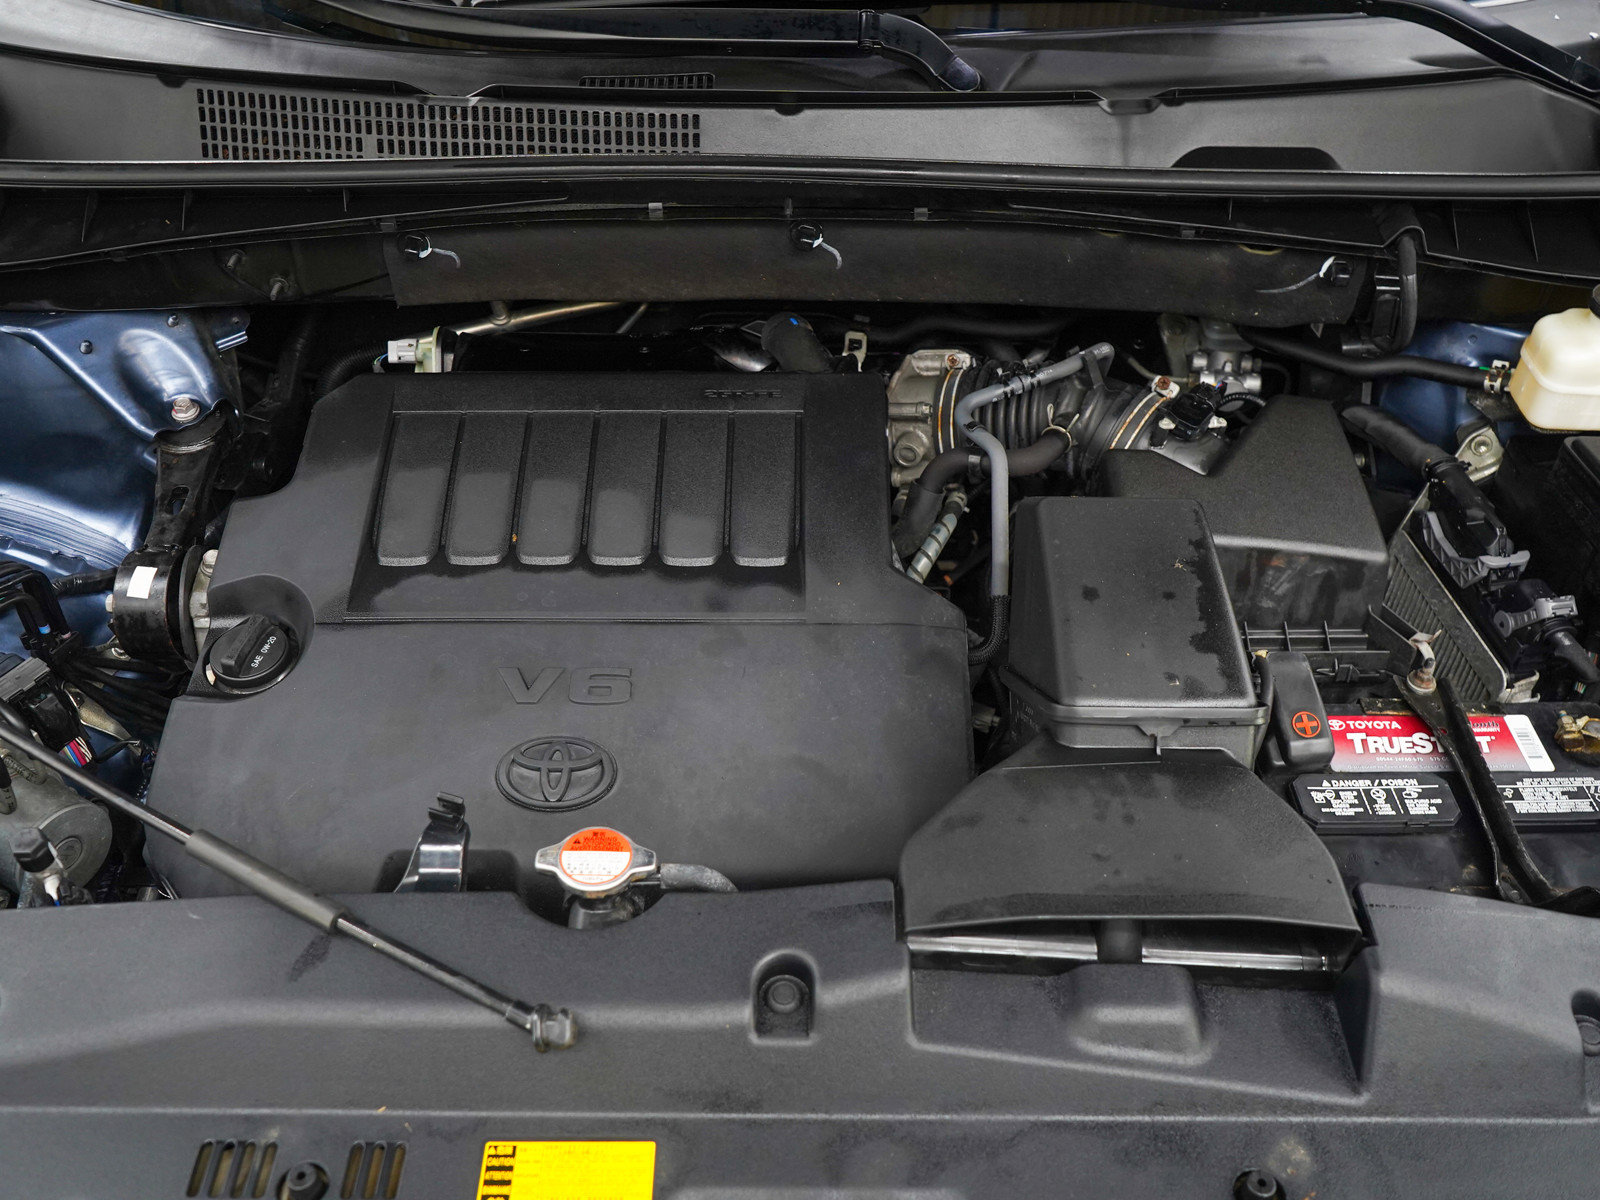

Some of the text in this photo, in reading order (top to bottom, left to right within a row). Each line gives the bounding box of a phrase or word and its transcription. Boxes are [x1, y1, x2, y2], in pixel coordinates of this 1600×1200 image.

[251, 636, 277, 668] SAE 0W-20
[497, 666, 633, 705] V6
[1346, 720, 1402, 730] TOYOTA
[1346, 732, 1492, 754] TRUESTT
[1331, 778, 1419, 787] DANGER / POISON
